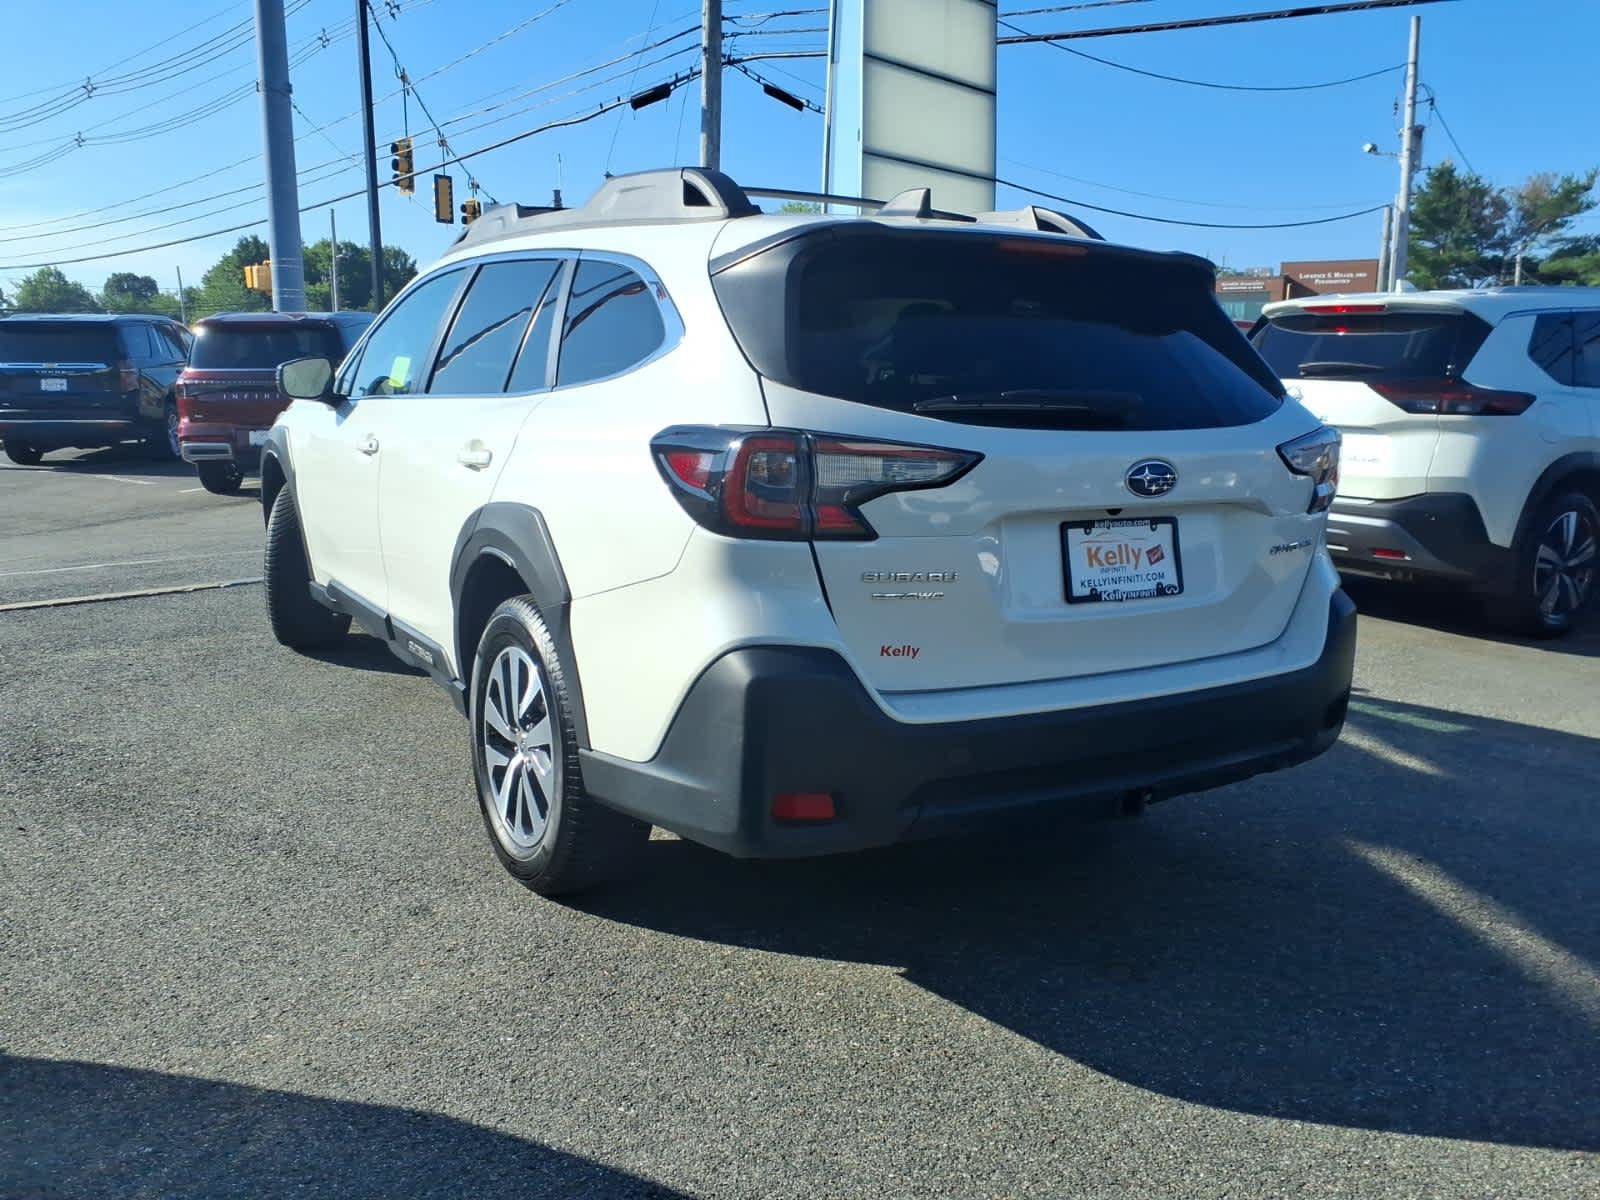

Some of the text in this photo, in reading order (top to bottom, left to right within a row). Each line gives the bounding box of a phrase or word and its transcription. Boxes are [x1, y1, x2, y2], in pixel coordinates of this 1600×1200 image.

[223, 392, 281, 400] INFINI
[1087, 543, 1142, 571] Kelly
[861, 571, 959, 584] SUBARU
[1080, 572, 1166, 589] KELLYINFINITI.COM
[880, 644, 921, 660] Kelly
